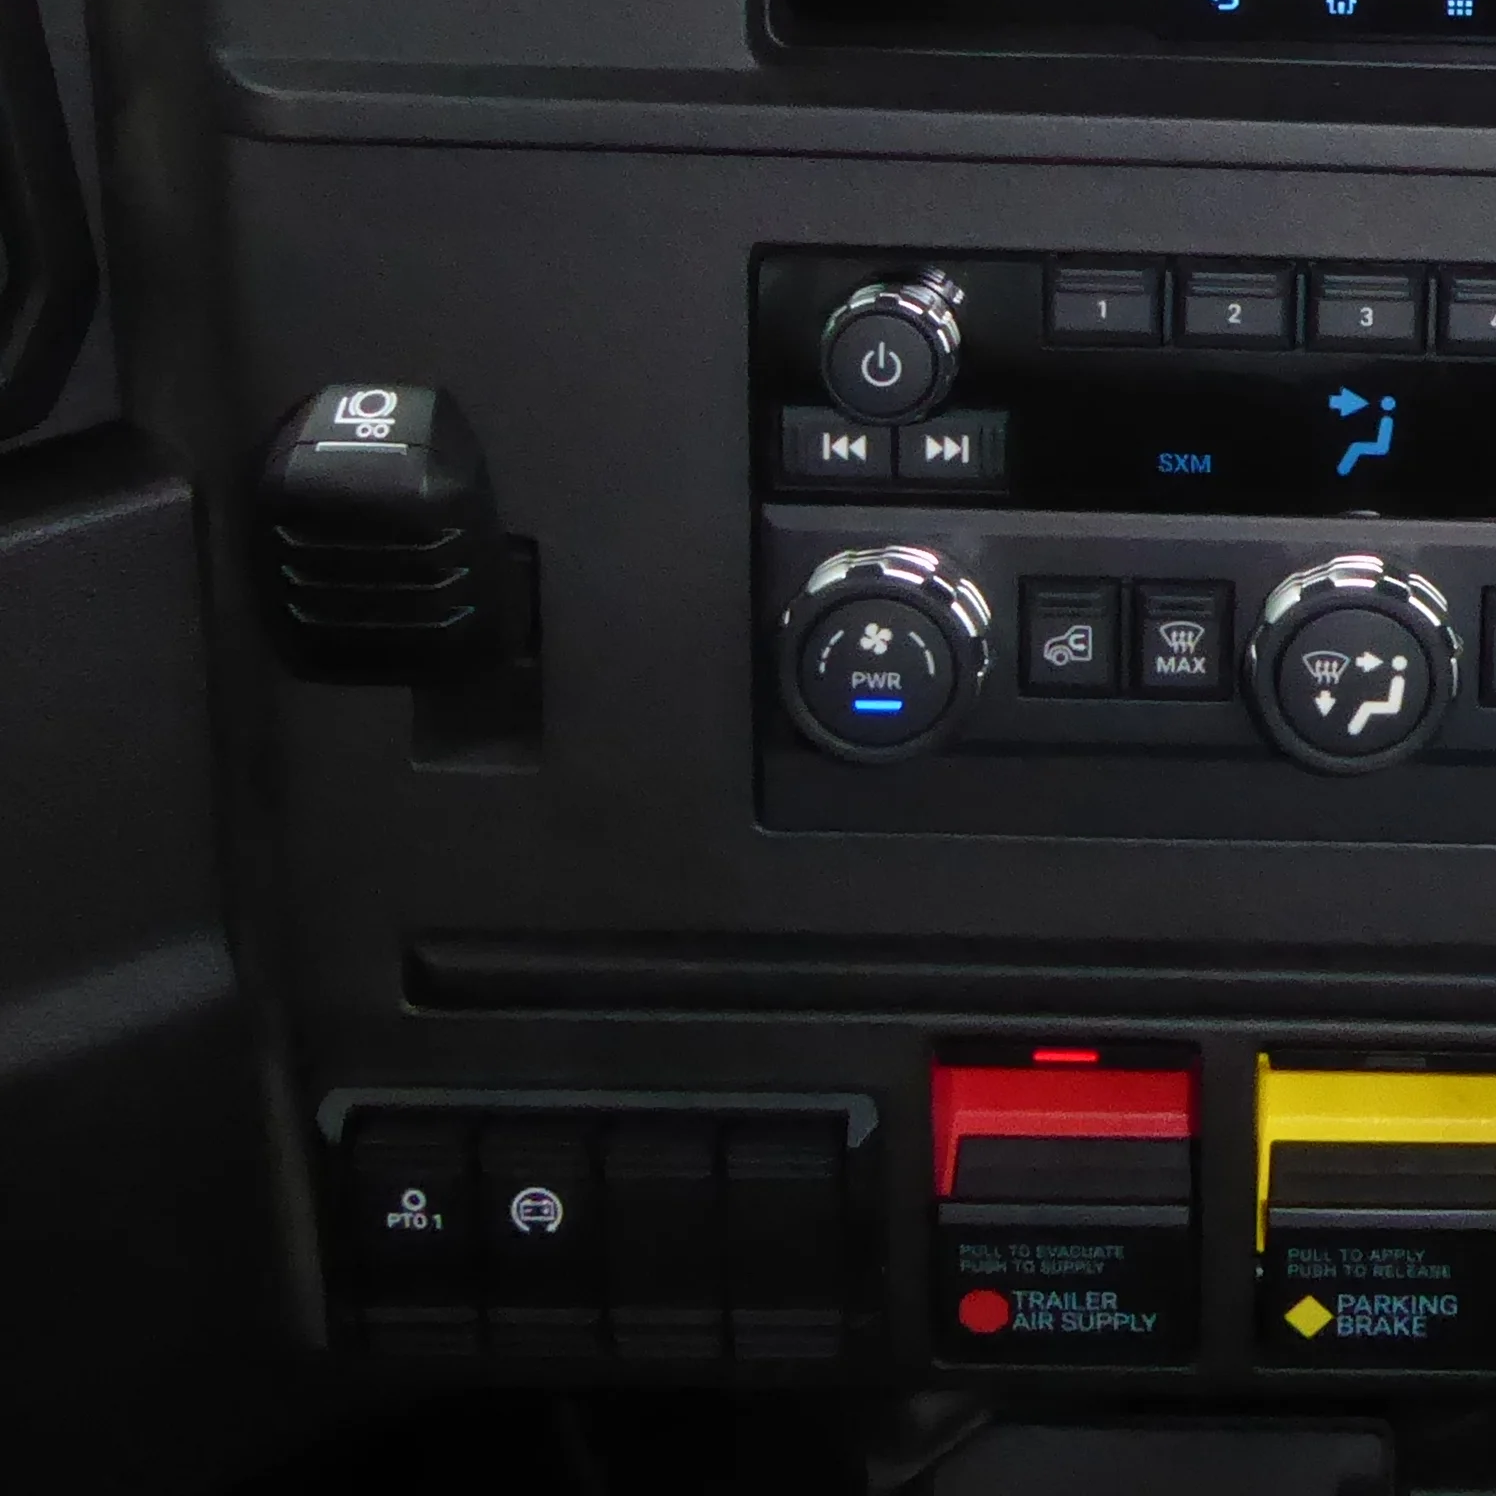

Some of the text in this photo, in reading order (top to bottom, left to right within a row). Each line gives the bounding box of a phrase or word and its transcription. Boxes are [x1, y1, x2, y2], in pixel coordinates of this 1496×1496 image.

[1096, 300, 1107, 320] 1
[1227, 303, 1242, 324] 2
[1360, 306, 1374, 327] 3
[1157, 453, 1212, 474] SXM
[1156, 655, 1206, 675] MAX
[851, 671, 902, 691] PWR
[387, 1213, 442, 1231] PTO 1
[1009, 1244, 1031, 1259] TO
[1287, 1248, 1333, 1263] PULL
[1339, 1248, 1364, 1263] TO
[1014, 1260, 1035, 1274] TO
[1287, 1264, 1337, 1279] PUSH
[1343, 1264, 1367, 1279] TO
[1011, 1290, 1118, 1310] TRAILER
[1337, 1293, 1458, 1316] PARKING
[1012, 1311, 1158, 1332] AIR SUPPLY
[1337, 1315, 1428, 1338] BRAKE
